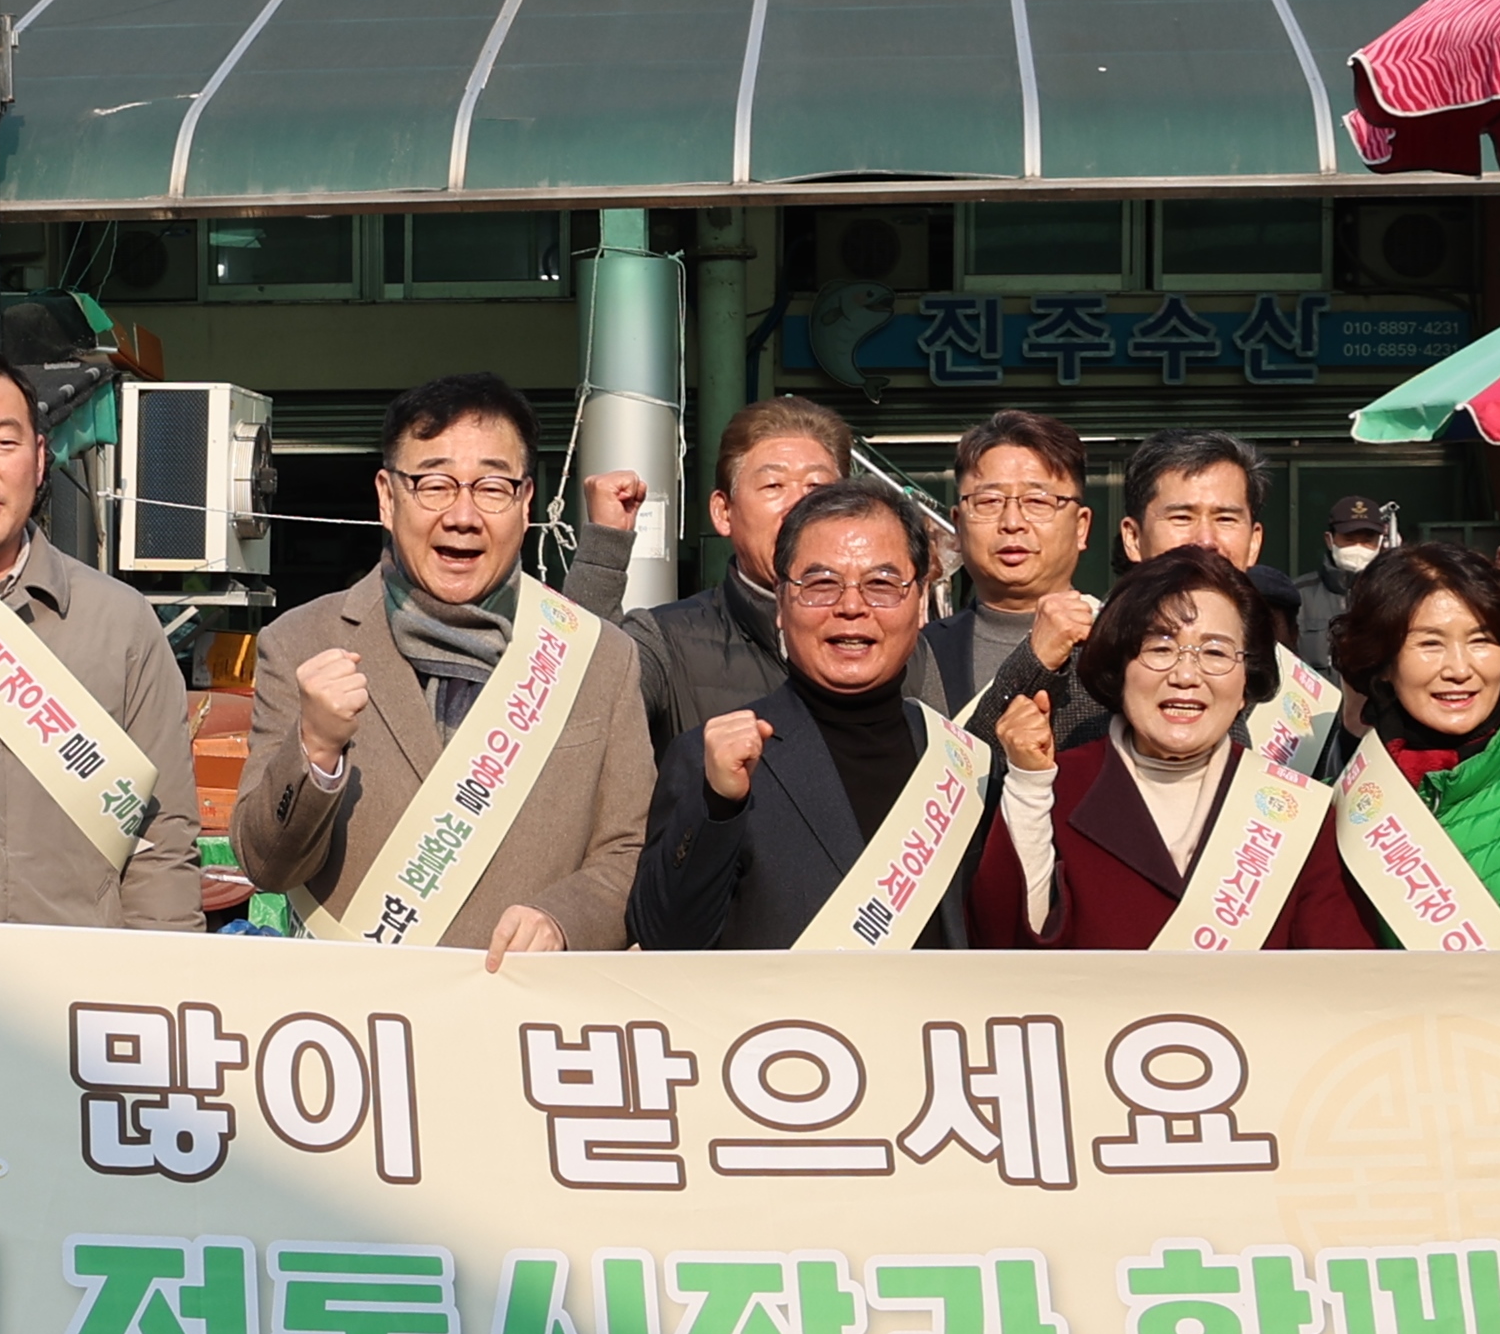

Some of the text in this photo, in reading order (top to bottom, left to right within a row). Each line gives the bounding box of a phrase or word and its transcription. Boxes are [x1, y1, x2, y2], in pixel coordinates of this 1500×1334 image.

[918, 294, 1330, 386] 진주수산
[505, 627, 567, 733] 전통시장
[454, 729, 521, 816] 이용을
[398, 813, 474, 899] 생활화
[852, 768, 966, 946] 지역경제를
[1212, 819, 1284, 927] 전통시장
[1365, 815, 1457, 924] 전통시장
[68, 1001, 421, 1186] 많이
[520, 1013, 1280, 1191] 받으세요
